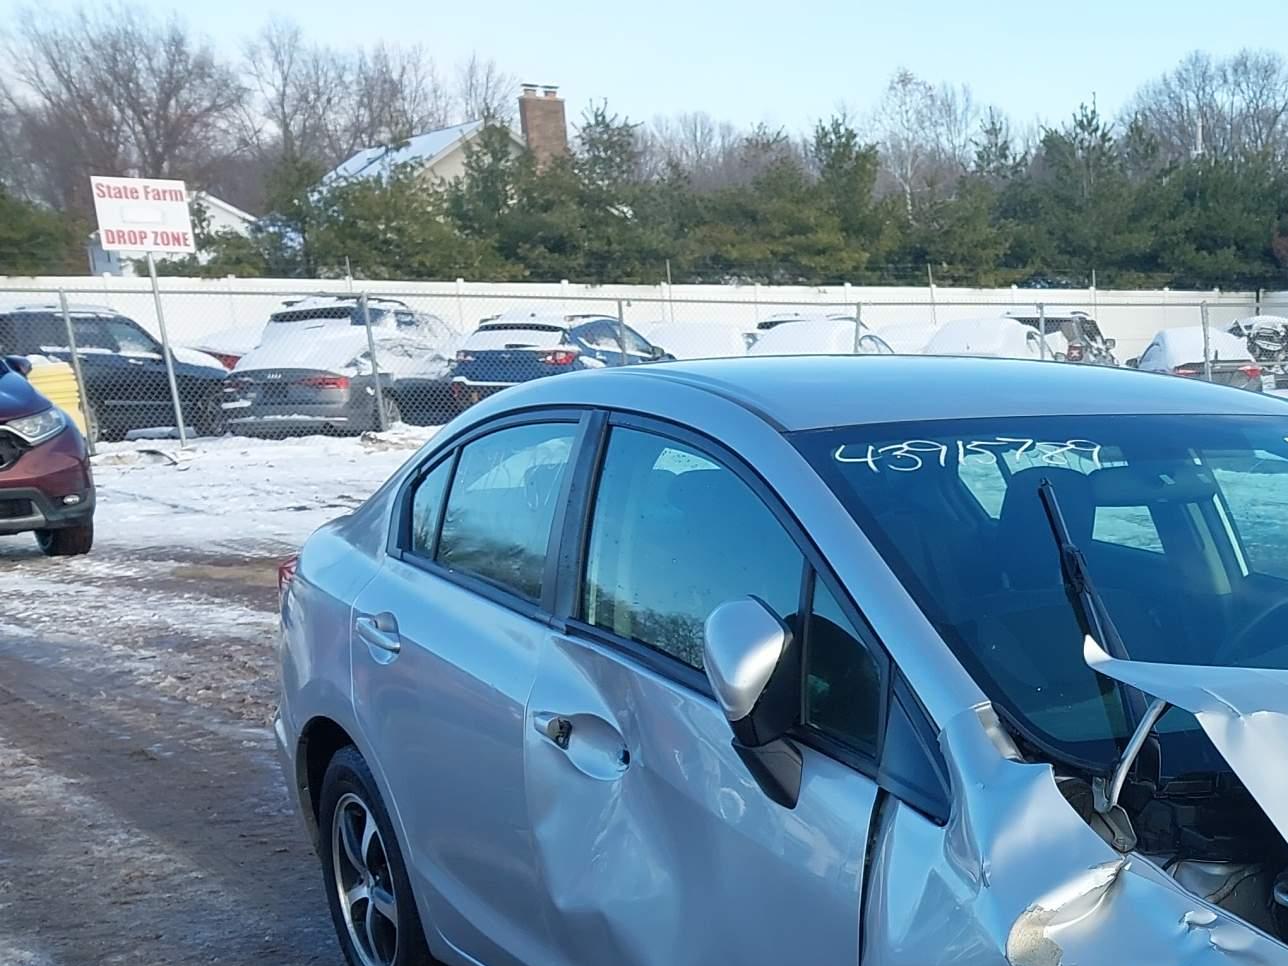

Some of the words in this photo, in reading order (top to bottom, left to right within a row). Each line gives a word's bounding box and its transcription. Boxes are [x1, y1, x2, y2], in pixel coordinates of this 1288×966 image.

[95, 183, 139, 200] State
[143, 185, 184, 202] Farm
[104, 229, 147, 246] DROP
[151, 231, 191, 247] ZONE
[834, 437, 1101, 473] 43915789
